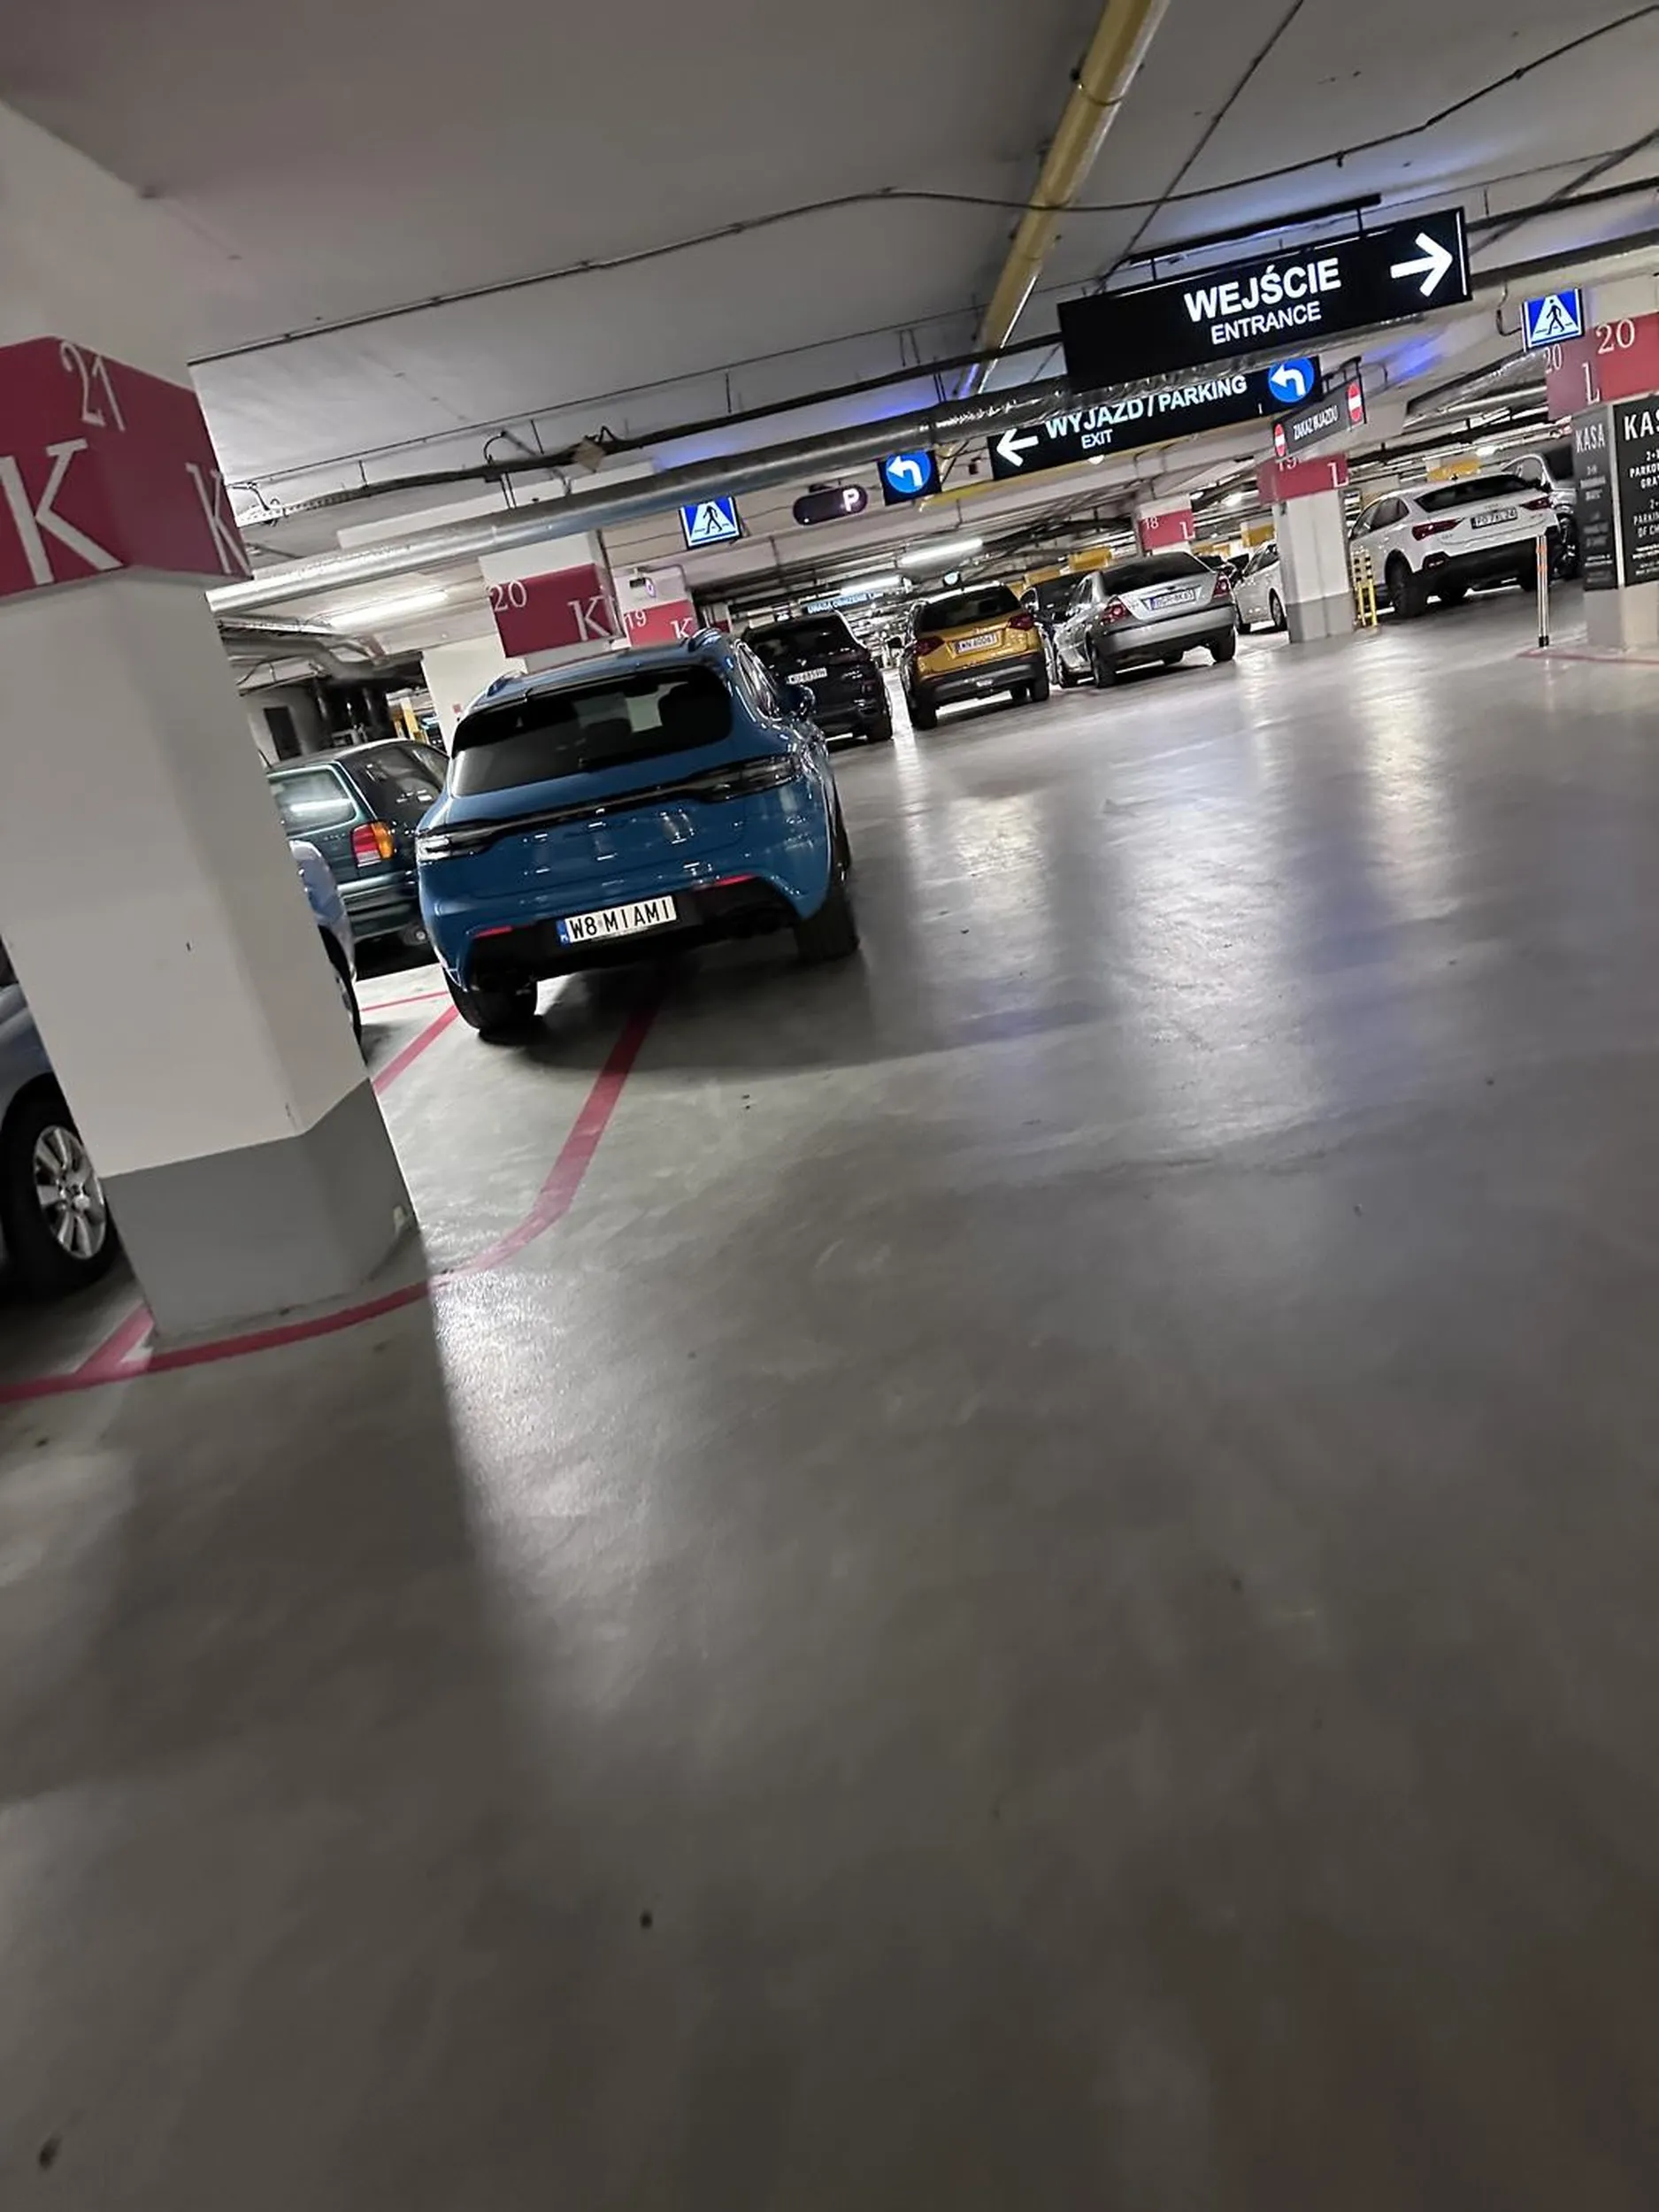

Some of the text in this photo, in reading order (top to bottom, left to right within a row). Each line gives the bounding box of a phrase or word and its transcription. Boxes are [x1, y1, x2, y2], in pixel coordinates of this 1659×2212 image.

[1183, 257, 1341, 322] WEJŚCIE
[1210, 301, 1322, 345] ENTRANCE
[1595, 319, 1635, 354] 20
[1542, 343, 1563, 374] 20
[60, 340, 126, 432] 21
[1581, 361, 1600, 405] L
[1044, 398, 1144, 439] WYJAZD
[1158, 375, 1248, 412] PARKING
[1081, 428, 1113, 449] EXIT
[1575, 423, 1606, 454] KASA
[1327, 462, 1349, 488] L
[0, 438, 127, 586] K
[842, 488, 860, 512] P
[185, 462, 251, 578] K
[1143, 516, 1159, 530] 18
[1179, 521, 1195, 540] L
[489, 580, 527, 611] 20
[567, 595, 612, 641] K
[625, 610, 647, 630] 19
[670, 618, 693, 641] K
[569, 900, 670, 939] W8 MIAMI
